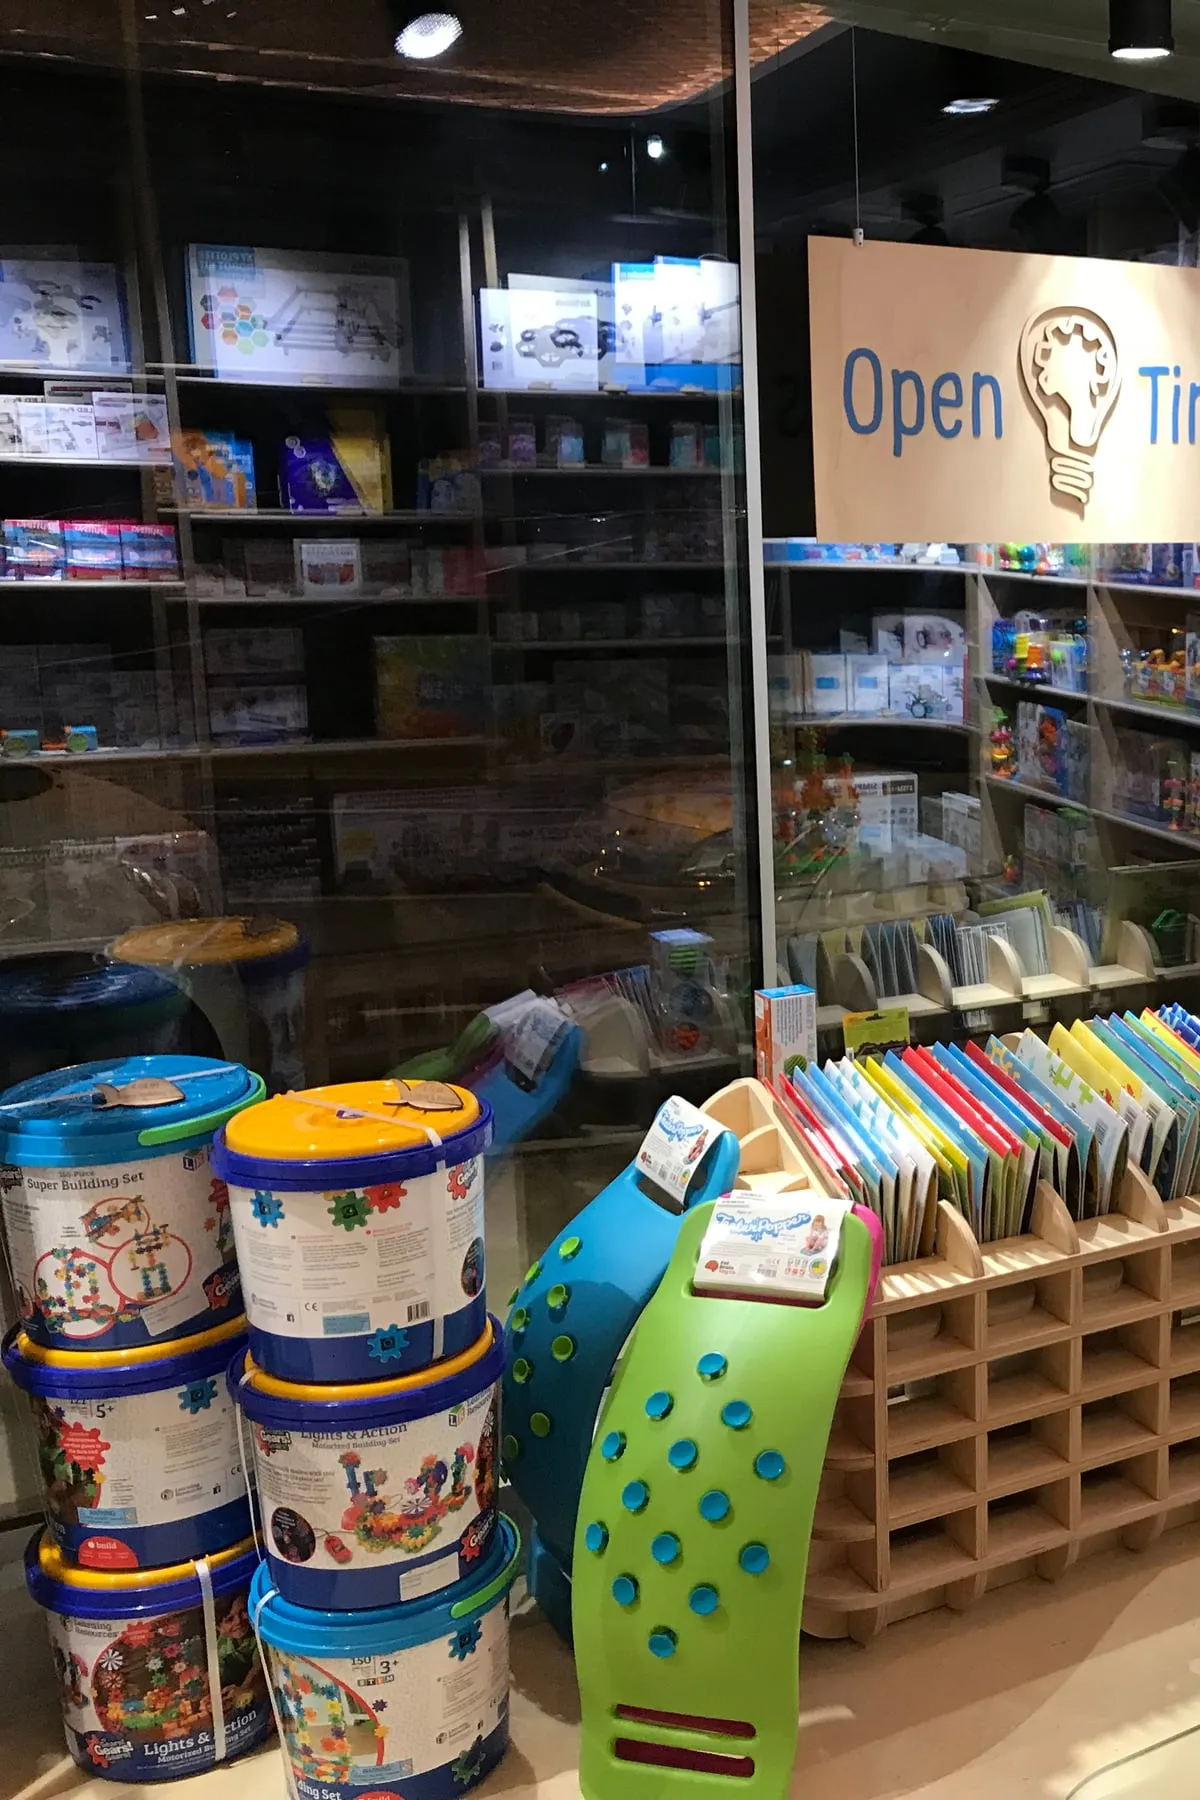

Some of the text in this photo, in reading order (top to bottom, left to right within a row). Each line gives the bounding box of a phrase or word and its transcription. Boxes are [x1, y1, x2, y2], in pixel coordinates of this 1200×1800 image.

[842, 347, 1004, 458] Open
[27, 1178, 60, 1193] Super
[61, 1175, 120, 1192] Building
[122, 1171, 146, 1184] Set
[95, 1404, 115, 1419] 5+
[300, 1422, 408, 1443] Lights & Action
[351, 1438, 387, 1450] Building
[387, 1436, 401, 1447] Set
[96, 1540, 118, 1550] build
[72, 1618, 112, 1632] Learning
[74, 1627, 119, 1639] Resources
[350, 1657, 372, 1665] 150
[379, 1659, 400, 1675] 3+
[143, 1709, 258, 1757] Lights & ction
[93, 1741, 134, 1756] Gears!
[156, 1748, 202, 1764] Motorized
[321, 1787, 342, 1800] Set
